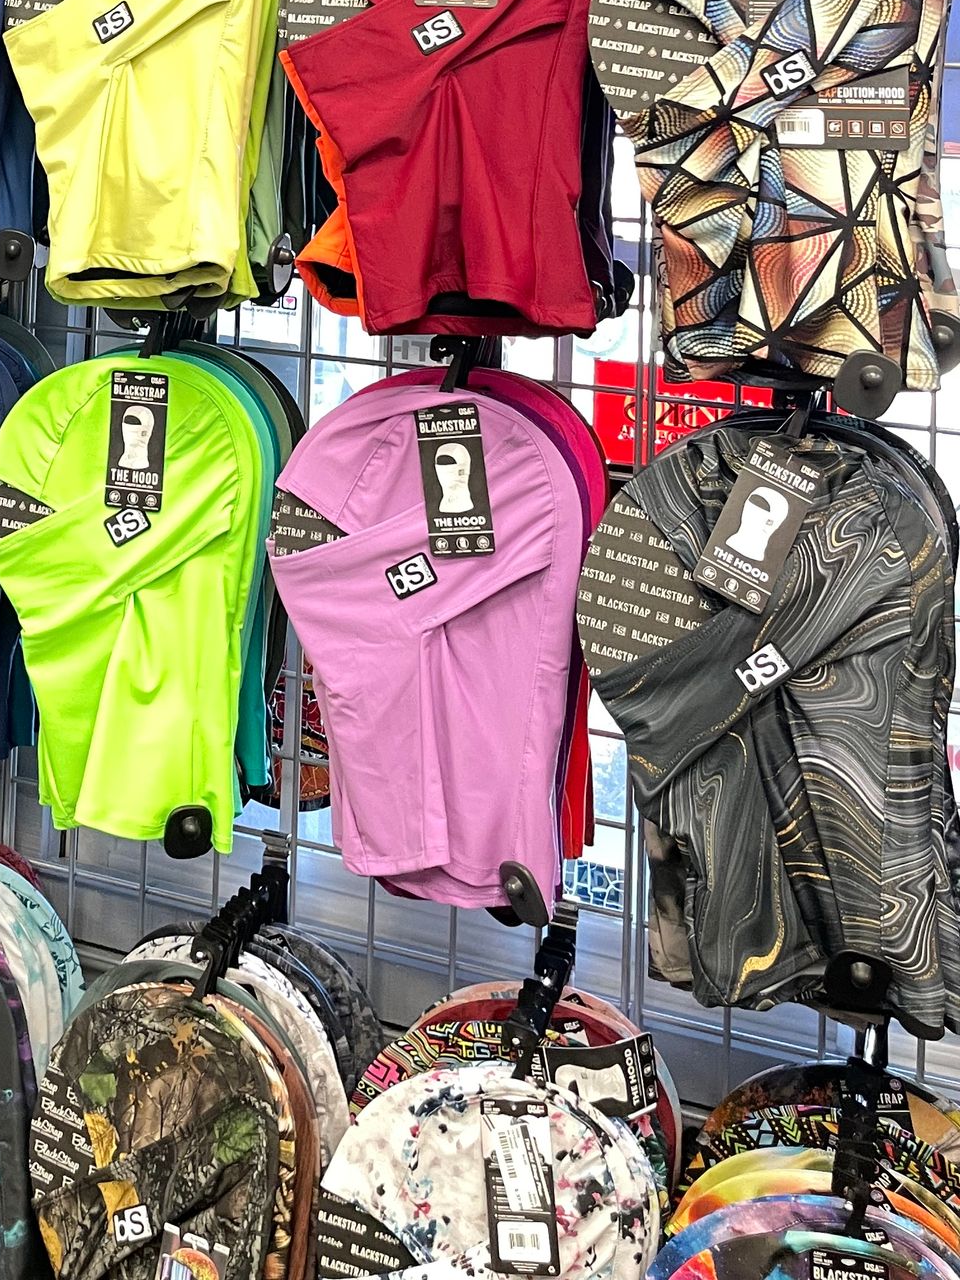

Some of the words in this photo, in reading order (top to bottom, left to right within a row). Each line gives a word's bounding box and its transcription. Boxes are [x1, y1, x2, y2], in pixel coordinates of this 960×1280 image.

[287, 13, 335, 25] BLACKSTRAP
[627, 21, 680, 38] BLACKSTRAP
[591, 37, 644, 54] BLACKSTRAP
[611, 63, 665, 81] BLACKSTRAP
[818, 86, 905, 99] EXPEDITION-HOOD
[113, 383, 166, 399] BLACKSTRAP
[419, 418, 477, 434] BLACKSTRAP
[111, 468, 128, 482] THE
[132, 471, 159, 486] HOOD
[749, 453, 816, 494] BLACKSTRAP
[434, 517, 452, 527] THE
[454, 516, 486, 527] HOOD
[605, 548, 659, 572] BLACKSTRAP
[713, 546, 733, 563] THE
[734, 559, 769, 583] HOOD
[640, 582, 694, 606] BLACKSTRAP
[597, 595, 651, 619] BLACKSTRAP
[624, 1048, 637, 1085] HOOD
[630, 1084, 640, 1106] THE
[317, 1210, 367, 1236] BLACKSTRAP
[350, 1243, 400, 1269] BLACKSTRAP
